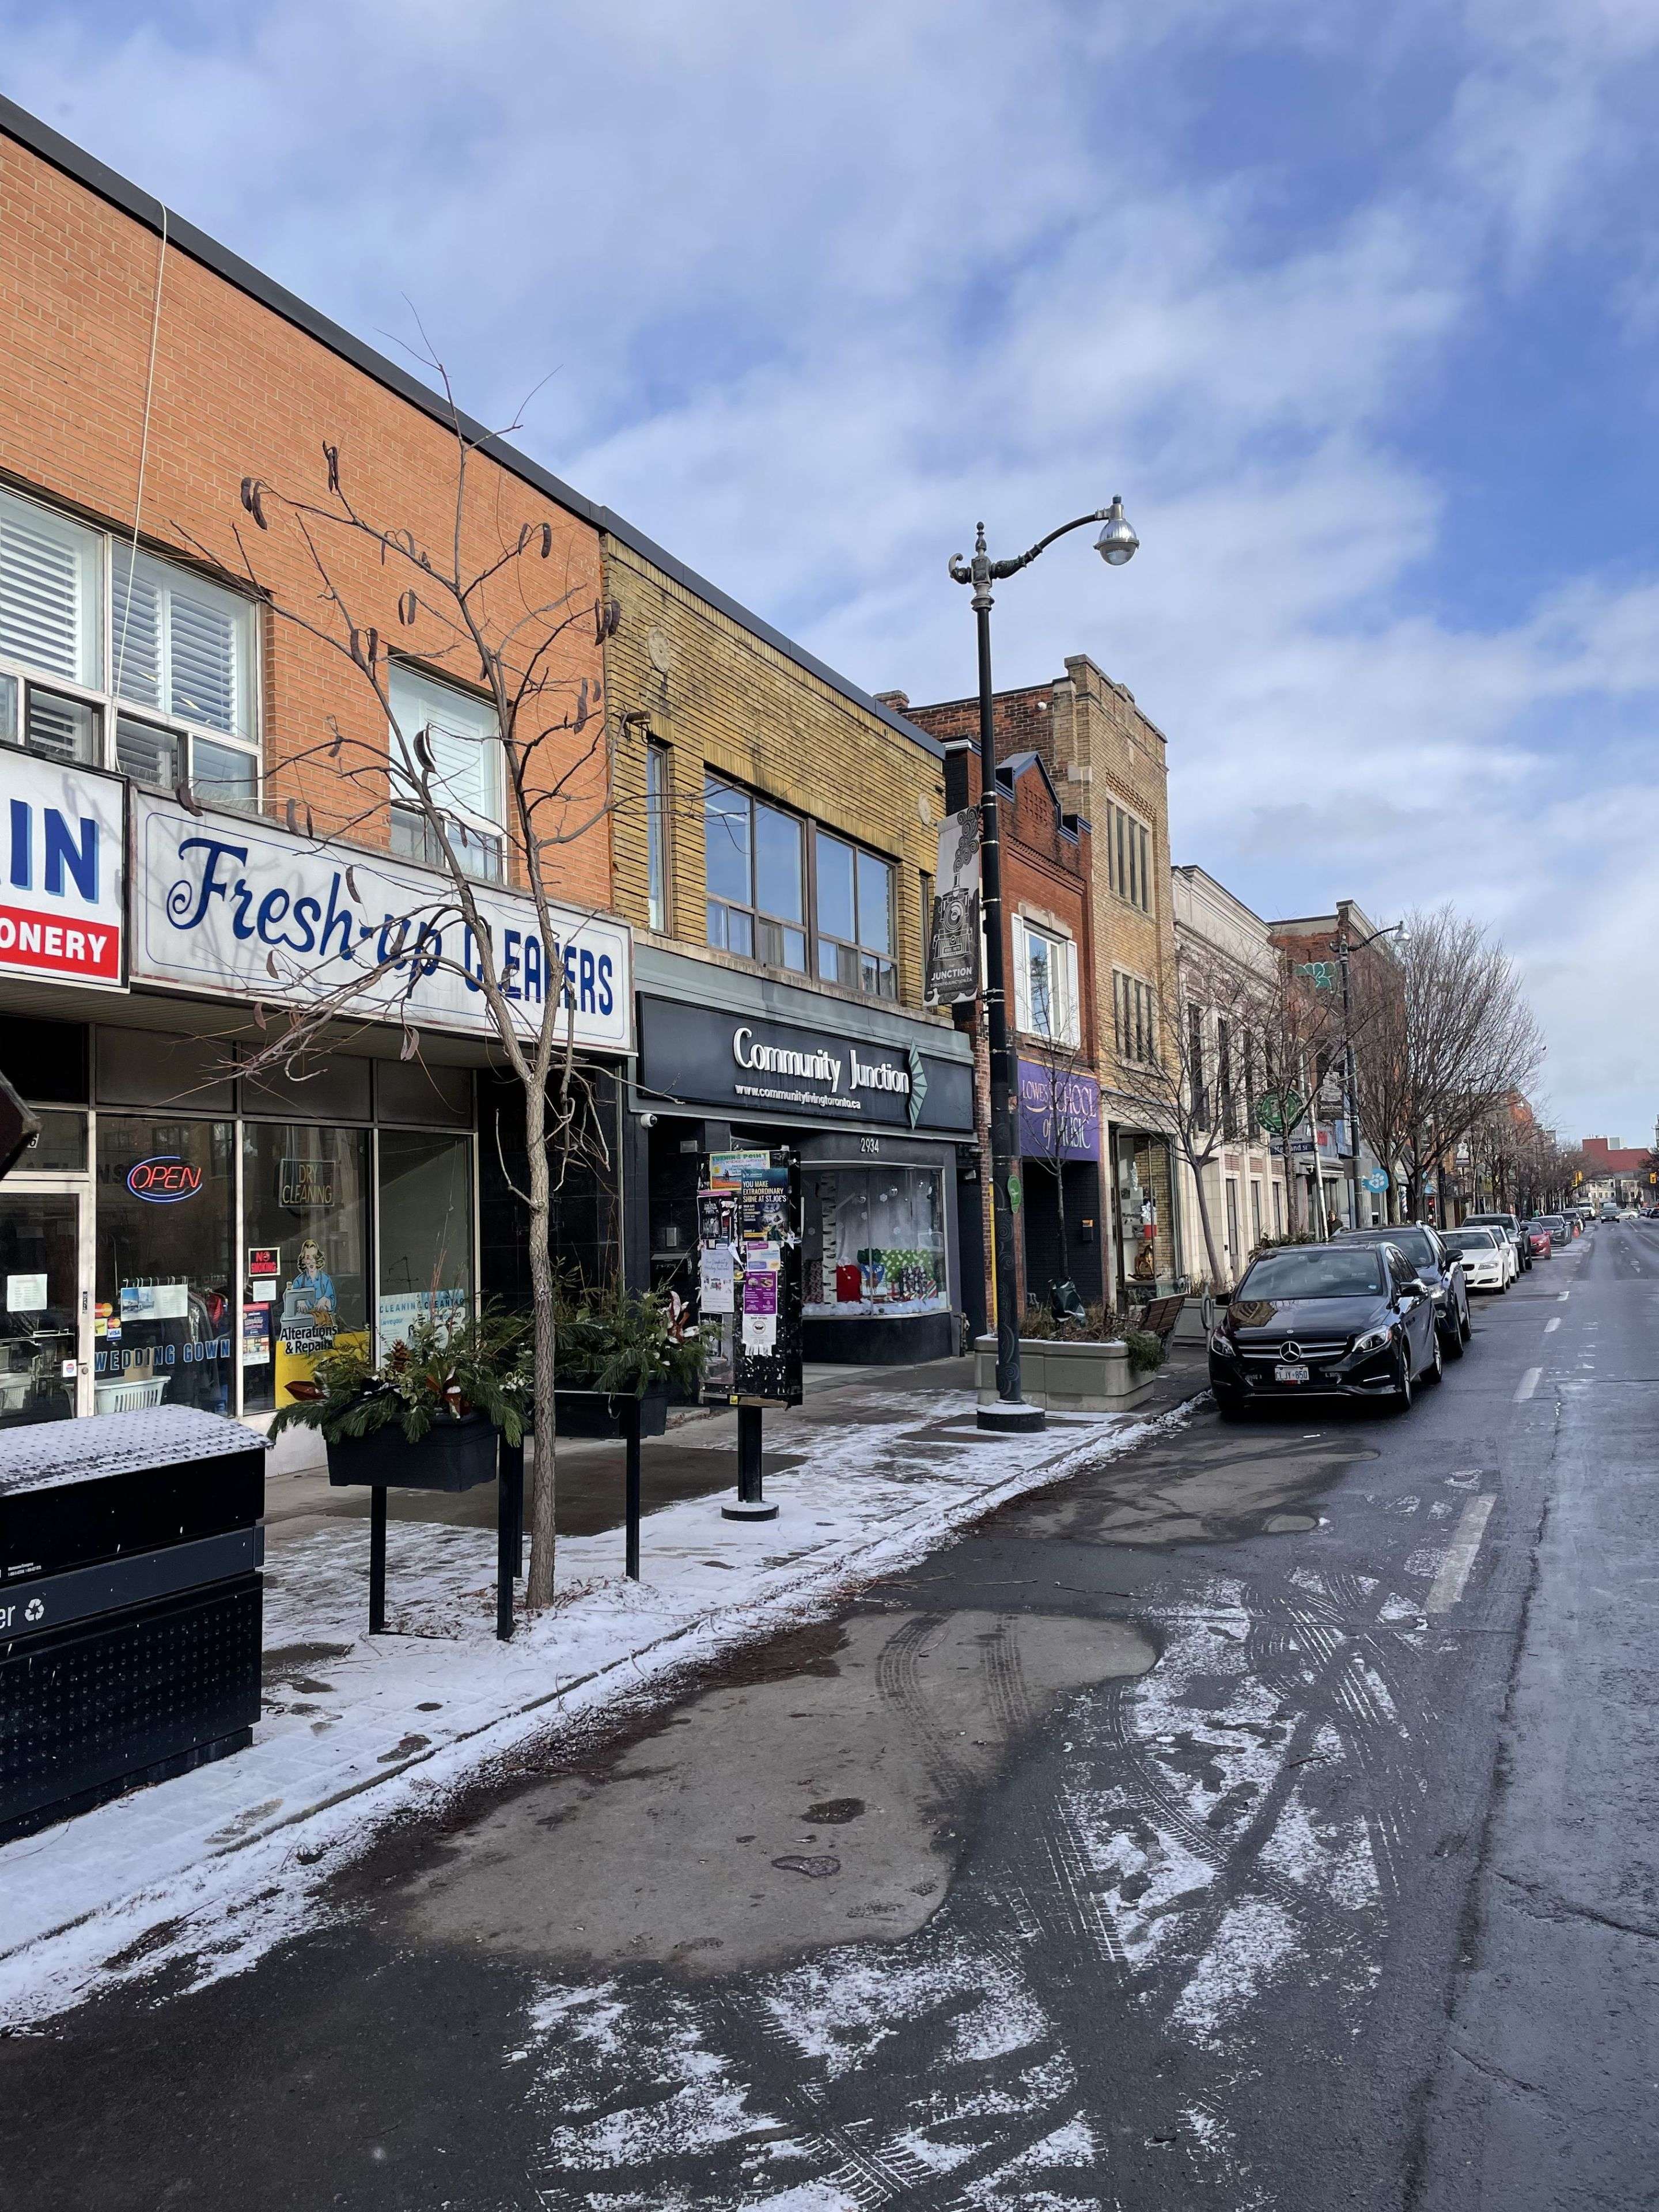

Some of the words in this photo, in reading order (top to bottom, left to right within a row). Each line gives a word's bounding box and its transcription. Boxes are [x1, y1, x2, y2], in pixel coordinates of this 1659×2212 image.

[8, 798, 99, 904] IN
[166, 838, 442, 999] Fresh-up
[464, 923, 613, 1016] CEAERS
[931, 967, 972, 981] JUNCTION
[733, 1028, 841, 1093] Community
[849, 1050, 910, 1093] Junction
[734, 1084, 861, 1109] www.communitylivingtoronto.ca
[861, 1137, 880, 1153] 2934
[131, 1165, 202, 1189] OPEN
[299, 1164, 318, 1183] DRY
[282, 1184, 332, 1204] CLEANING
[255, 1251, 271, 1262] NO
[251, 1262, 277, 1272] SMOKING
[281, 1325, 338, 1341] Alterations
[94, 1344, 175, 1372] WEDDING
[183, 1339, 230, 1363] GOWN
[285, 1342, 293, 1354] &
